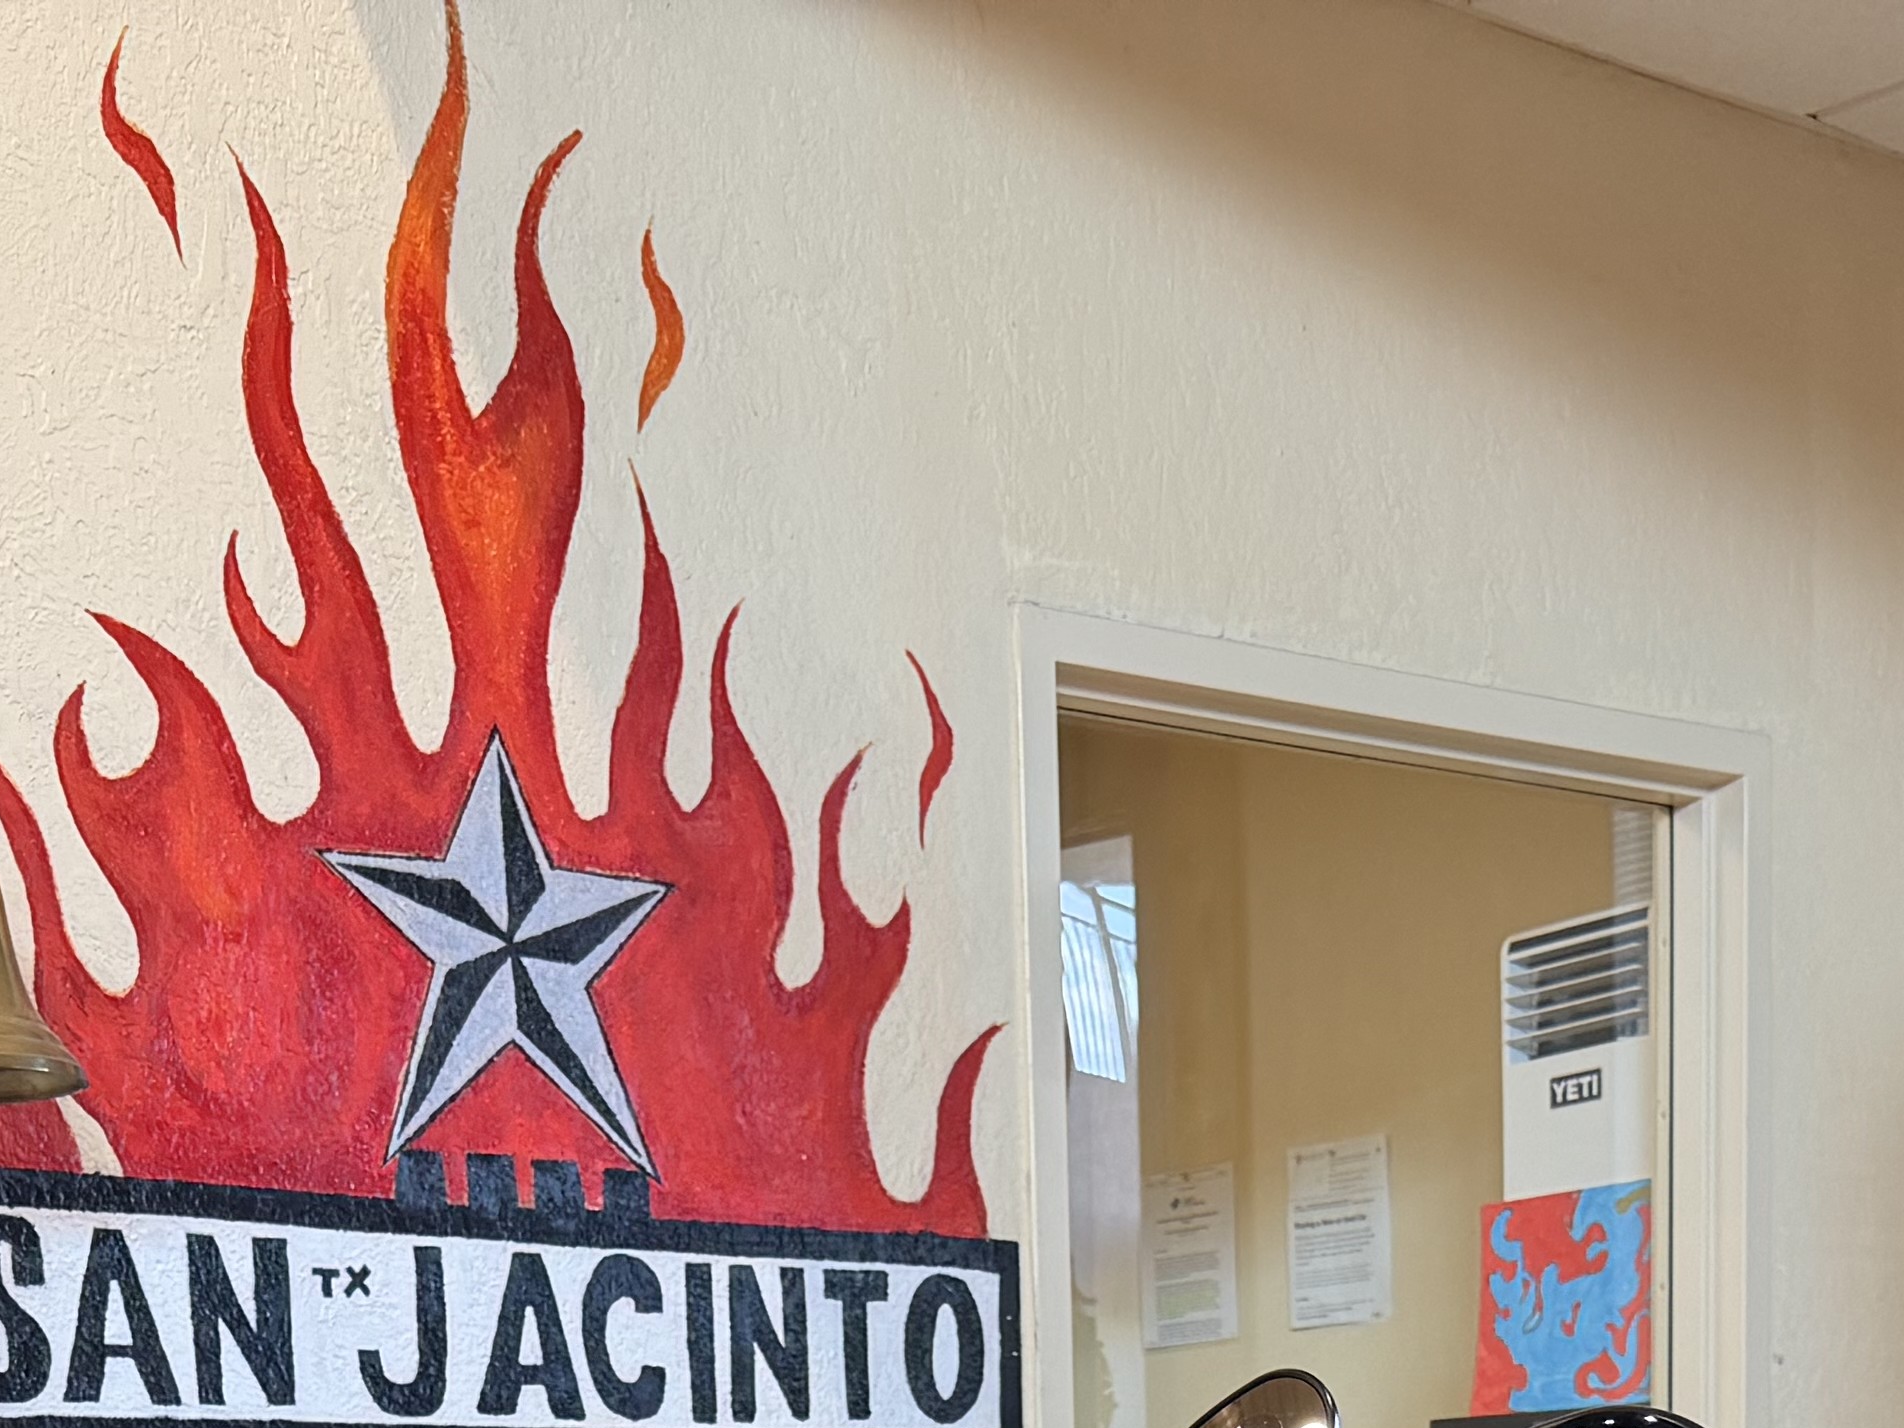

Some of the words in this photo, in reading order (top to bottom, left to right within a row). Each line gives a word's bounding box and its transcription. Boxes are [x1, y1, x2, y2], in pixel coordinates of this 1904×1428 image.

[1552, 1074, 1598, 1103] YETI
[312, 1264, 372, 1298] TX
[359, 1244, 985, 1425] JACINTO
